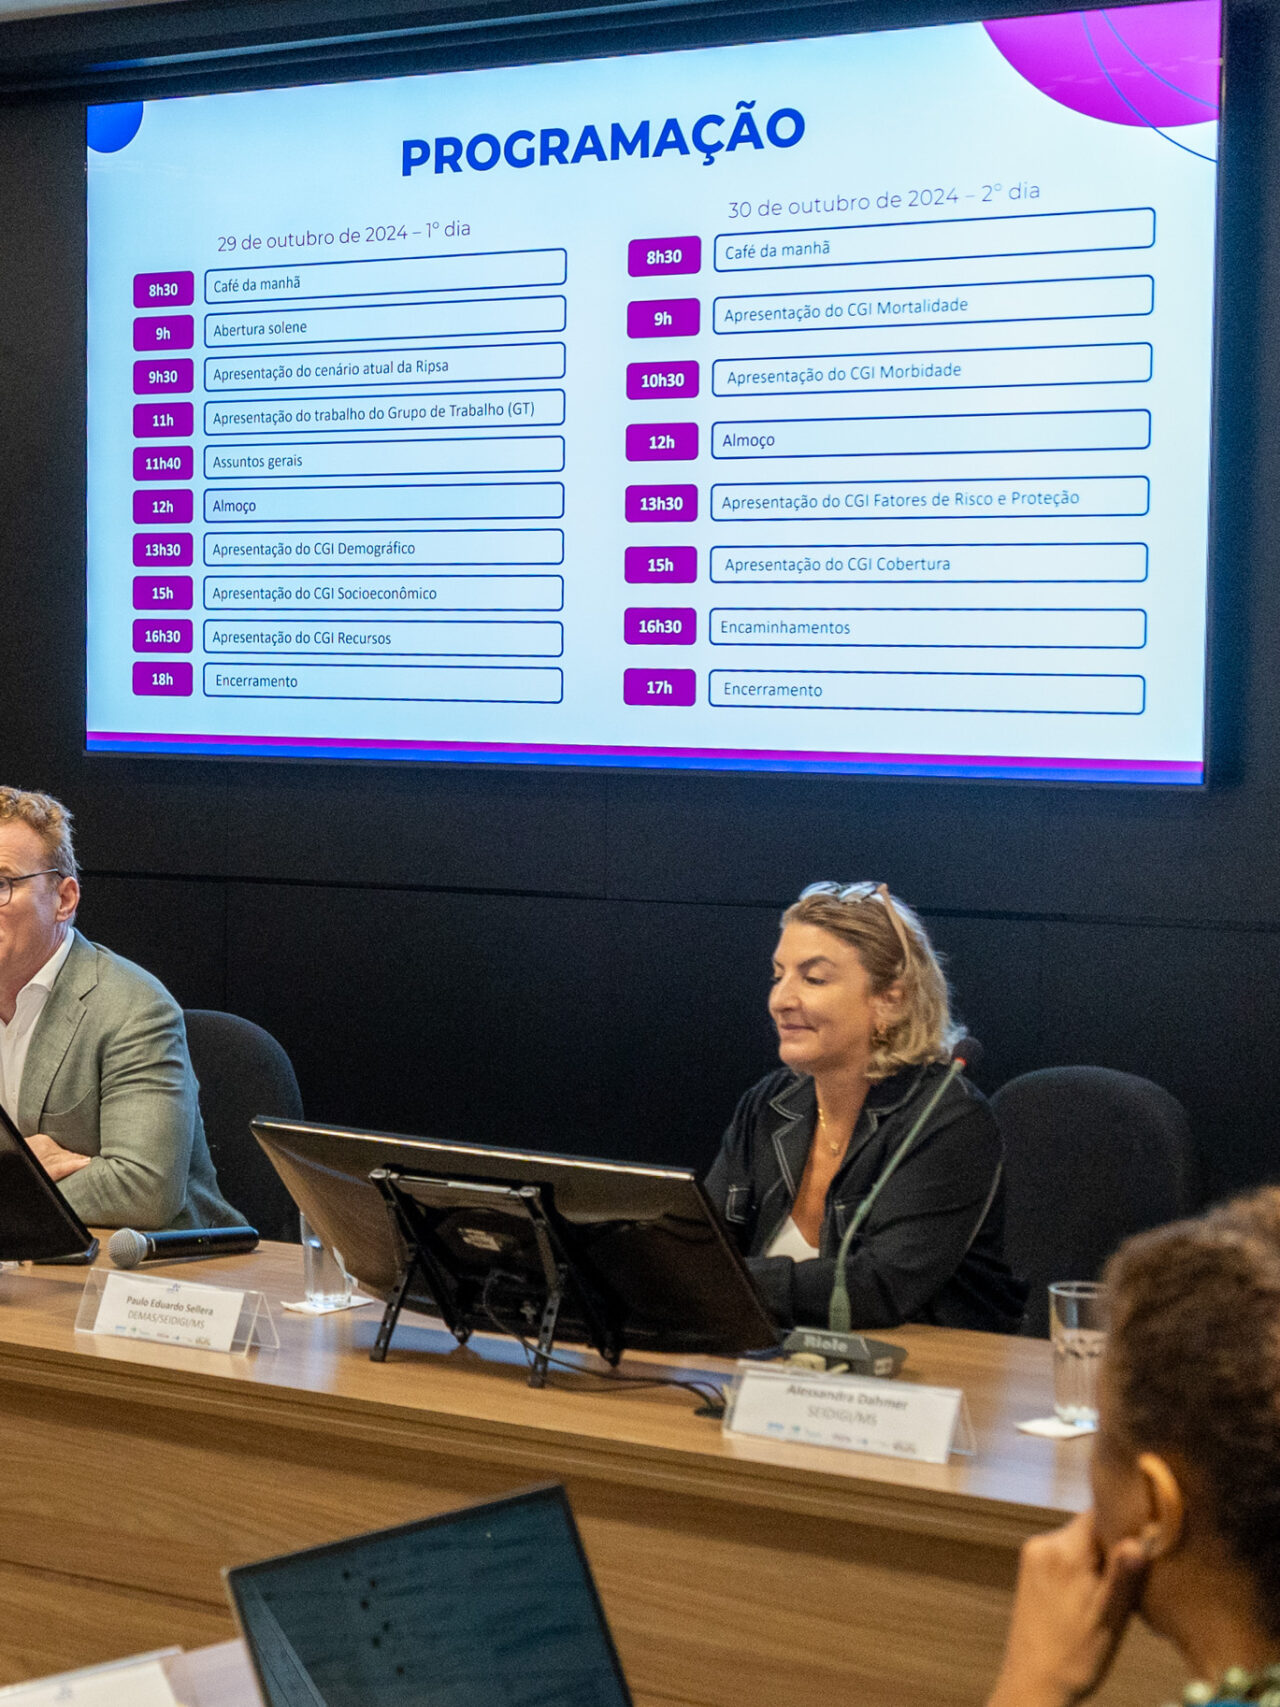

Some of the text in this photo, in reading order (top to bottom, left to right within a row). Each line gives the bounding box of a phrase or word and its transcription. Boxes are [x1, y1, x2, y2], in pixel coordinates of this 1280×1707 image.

[401, 99, 806, 177] PROGRAMAÇÃO
[727, 201, 752, 219] 30
[757, 199, 783, 217] de
[787, 194, 871, 215] outubro
[876, 190, 903, 209] de
[907, 187, 960, 208] 2024
[1008, 181, 1041, 201] dia
[217, 235, 237, 252] 29
[241, 233, 262, 251] de
[266, 229, 335, 249] outubro
[338, 226, 361, 244] de
[364, 224, 409, 243] 2024
[444, 219, 471, 238] dia
[646, 248, 683, 265] 8h30
[725, 239, 831, 260] Café da manhã
[148, 282, 179, 298] 8h30
[213, 275, 301, 294] Café da manhã
[653, 311, 673, 327] 9h
[723, 297, 969, 325] Apresentação do CGI Mortalidade
[155, 326, 171, 341] 9h
[213, 320, 308, 337] Abertura solene
[148, 369, 178, 384] 9h30
[213, 359, 449, 384] Apresentação do cenário atual da Ripsa
[726, 362, 962, 388] Apresentação do CGI Morbidade
[641, 372, 685, 388] 10h30
[152, 413, 174, 427] 11h
[212, 401, 535, 427] Apresentação do trabalho do Grupo de Trabalho (GT)
[649, 434, 676, 450] 12h
[722, 432, 776, 450] Almoço
[145, 456, 182, 471] 11h40
[212, 453, 303, 471] Assuntos gerais
[152, 499, 174, 514] 12h
[212, 499, 257, 515] Almoço
[640, 496, 684, 512] 13h30
[721, 489, 1080, 513] Apresentação do CGI Fatores de Risco e Proteção
[145, 543, 181, 557] 13h30
[212, 540, 416, 559] Apresentação do CGI Demográfico
[647, 557, 674, 573] 15h
[724, 556, 951, 575] Apresentação do CGI Cobertura
[152, 586, 174, 600] 15h
[212, 585, 438, 603] Apresentação do CGI Socioeconômico
[639, 619, 683, 634] 16h30
[720, 620, 851, 635] Encaminhamentos
[145, 629, 181, 644] 16h30
[212, 630, 392, 647] Apresentação do CGI Recursos
[151, 672, 174, 686] 18h
[215, 673, 298, 688] Encerramento
[647, 679, 673, 695] 17h
[723, 681, 823, 698] Encerramento
[127, 1296, 213, 1316] Paulo Eduardo Sellera
